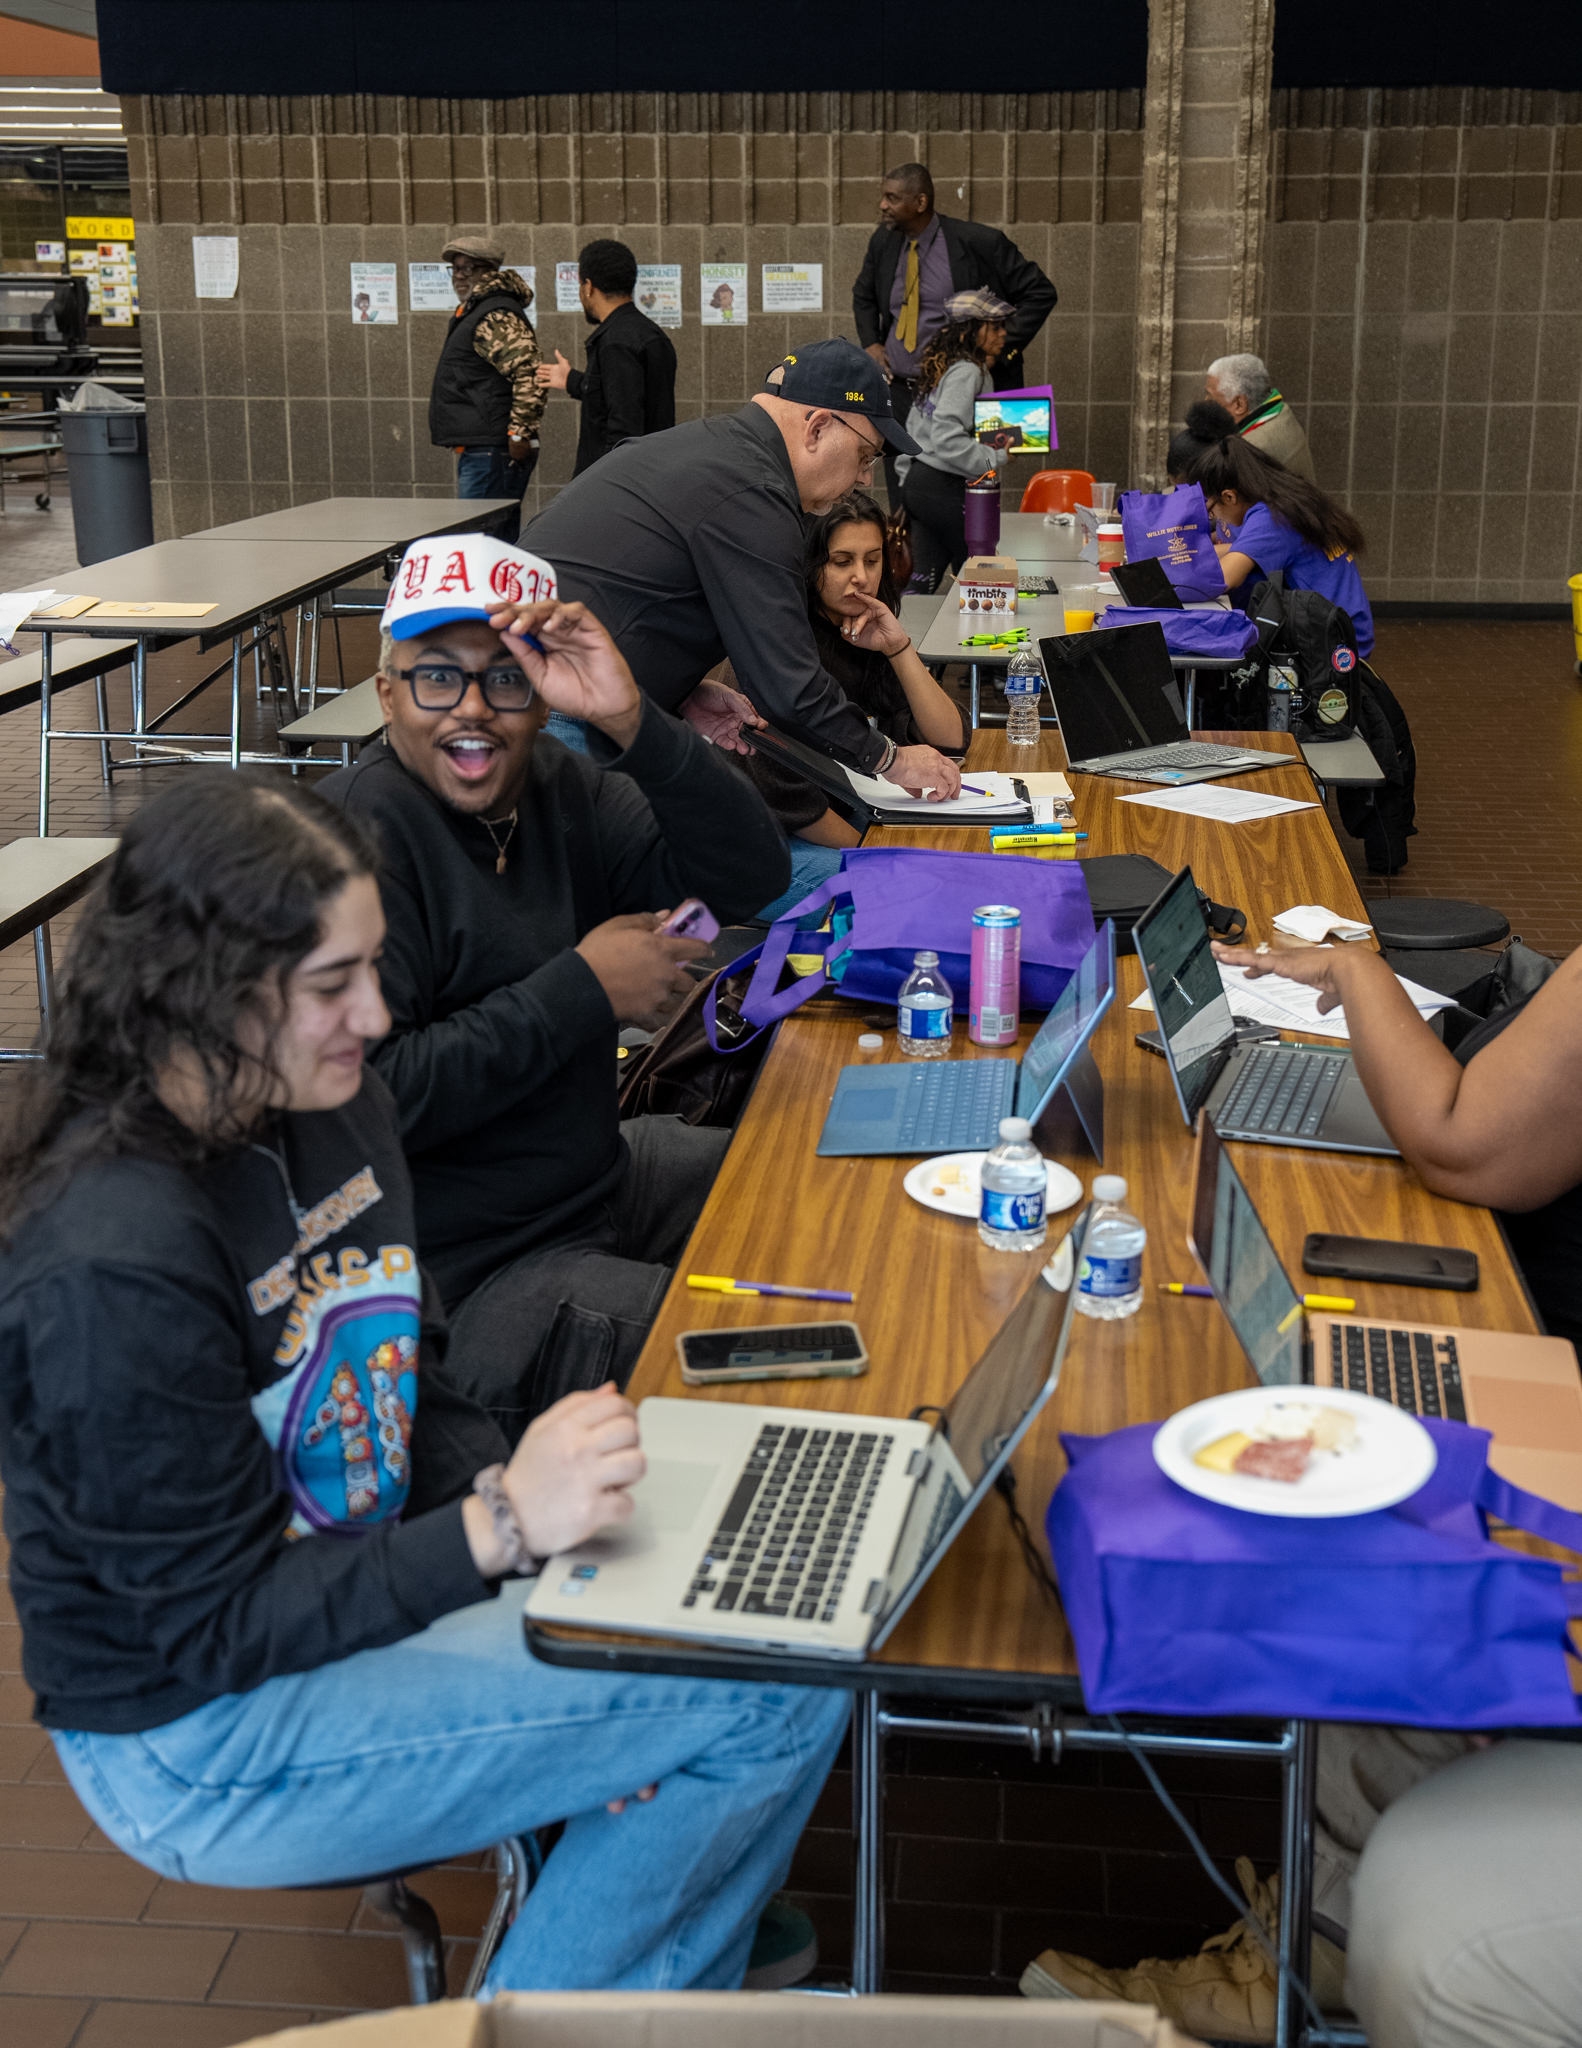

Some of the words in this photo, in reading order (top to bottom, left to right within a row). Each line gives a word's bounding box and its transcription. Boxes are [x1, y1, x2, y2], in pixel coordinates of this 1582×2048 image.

[702, 267, 745, 277] HONESTY
[765, 272, 809, 281] GRATITUDE
[845, 391, 865, 402] 1984
[1146, 529, 1167, 538] WILLIE
[967, 588, 1007, 599] timbits
[1019, 1205, 1040, 1217] Life
